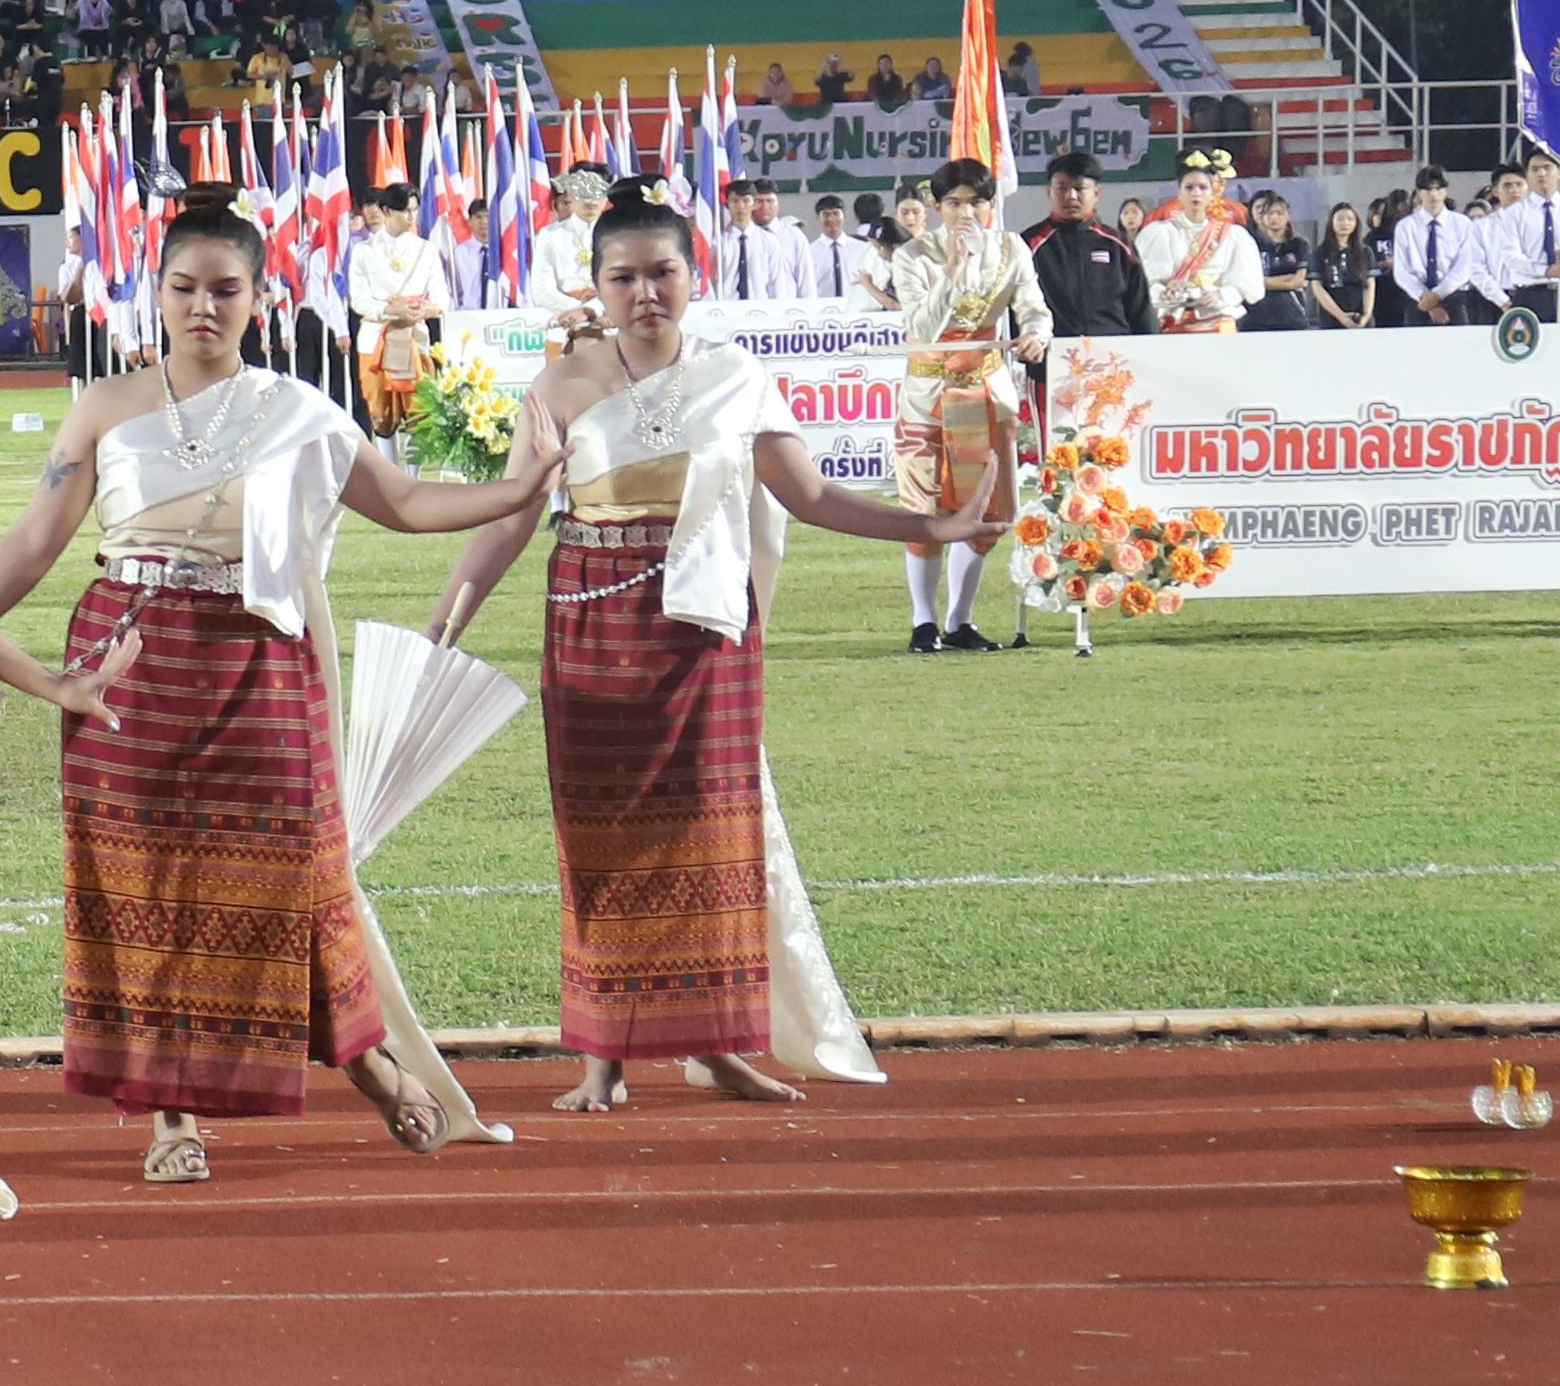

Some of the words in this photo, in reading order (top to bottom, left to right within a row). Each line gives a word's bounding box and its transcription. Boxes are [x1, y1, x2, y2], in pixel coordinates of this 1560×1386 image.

[1223, 508, 1364, 539] MPHAENG
[1384, 505, 1460, 538] PHET
[1477, 503, 1560, 534] RAJA
